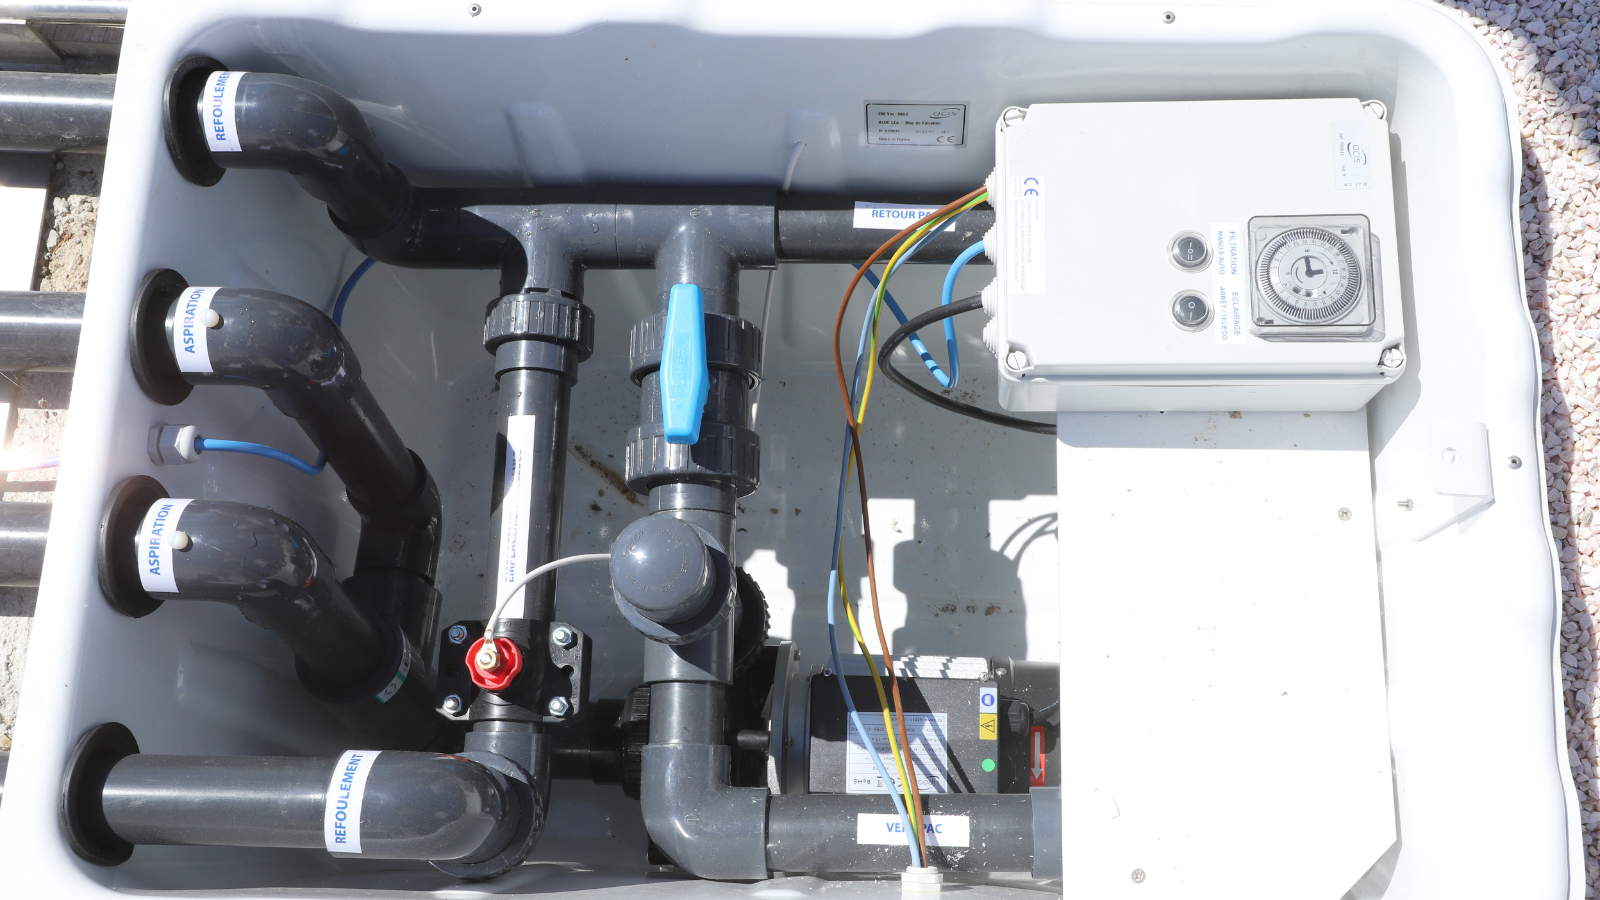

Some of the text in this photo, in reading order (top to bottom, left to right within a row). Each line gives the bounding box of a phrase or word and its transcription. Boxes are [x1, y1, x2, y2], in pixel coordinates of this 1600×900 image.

[213, 71, 232, 140] REFOULEMEN
[872, 210, 931, 219] RETOUR PA
[1229, 231, 1241, 336] FILTRATION ECLAIRAGE
[183, 288, 205, 354] ASPIRATION
[149, 504, 174, 575] ASPIRATION
[335, 754, 363, 844] REFOULEMENT
[886, 822, 904, 832] VE
